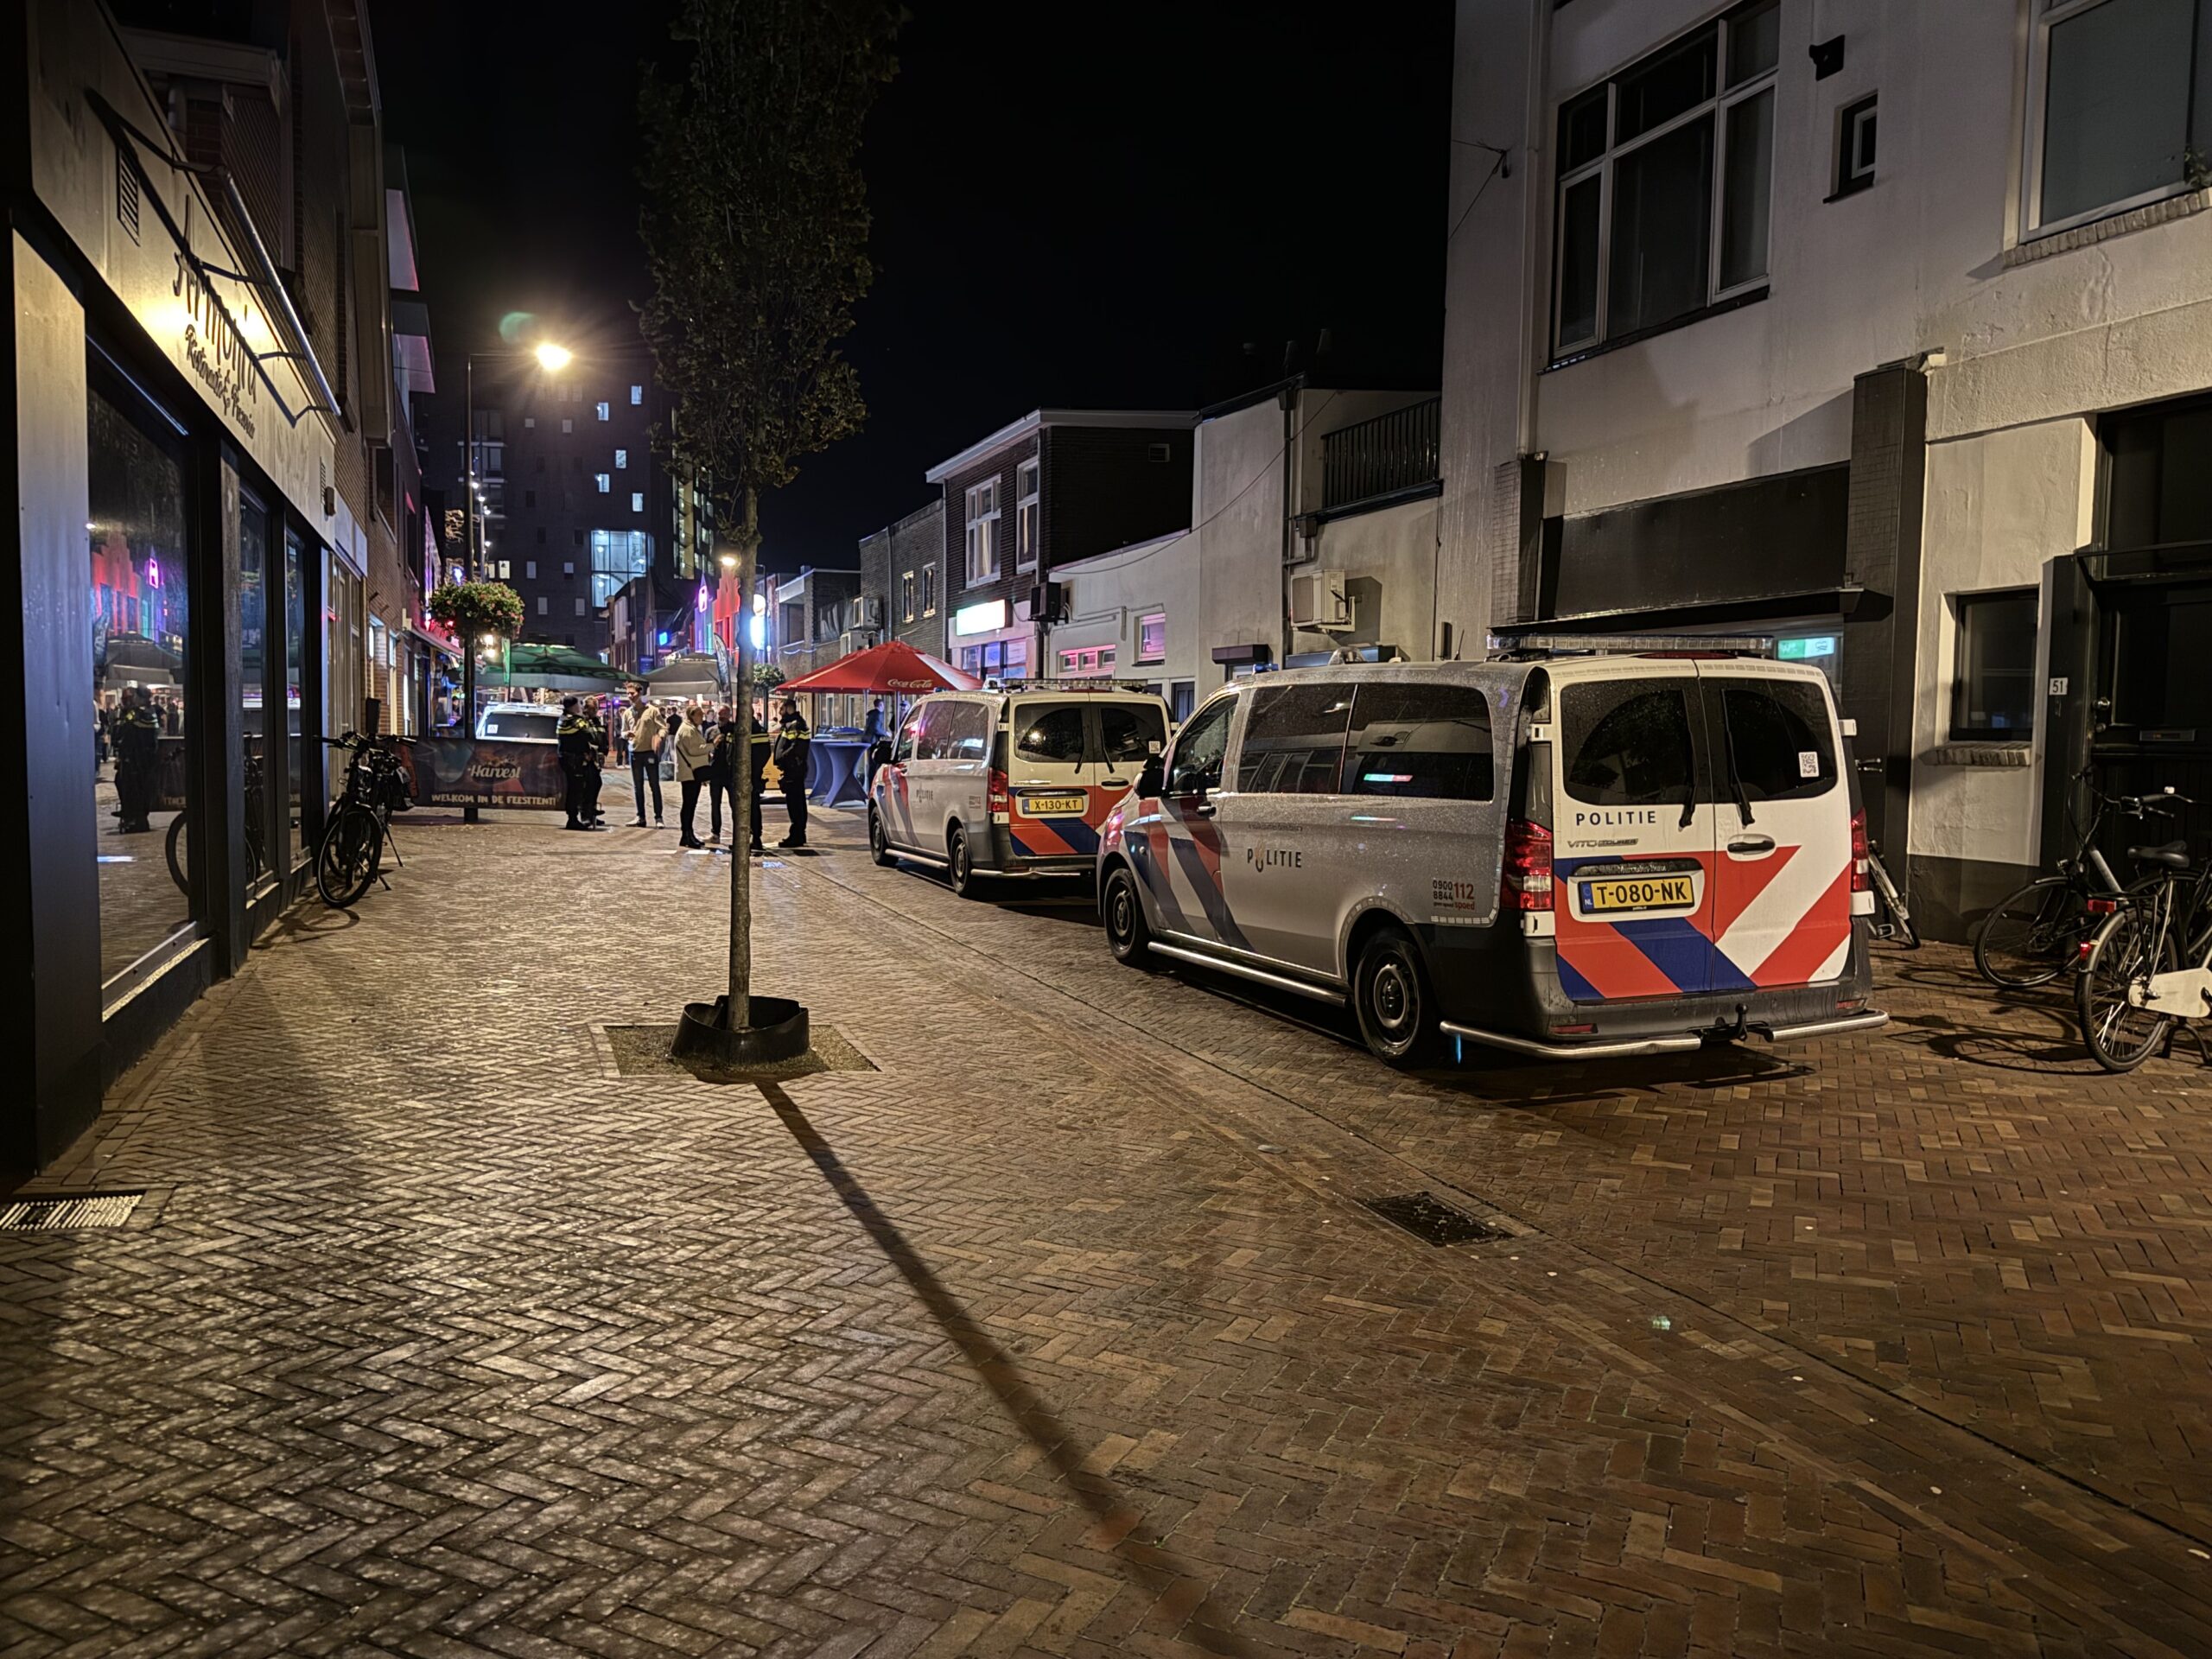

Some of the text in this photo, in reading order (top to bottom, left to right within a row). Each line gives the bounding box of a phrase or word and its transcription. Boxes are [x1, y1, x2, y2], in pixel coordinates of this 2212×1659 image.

[2052, 680, 2063, 693] 51
[431, 794, 474, 803] WELKOM
[477, 795, 488, 804] IN
[492, 795, 504, 804] DE
[1034, 799, 1078, 810] X-130-KT
[1575, 810, 1656, 826] POLITIE
[1247, 843, 1302, 873] POLITIE
[1433, 880, 1452, 891] 0900
[1453, 882, 1474, 899] 112
[1433, 891, 1453, 900] 8844
[1597, 881, 1688, 905] T-080-NK
[1454, 901, 1475, 911] spoed
